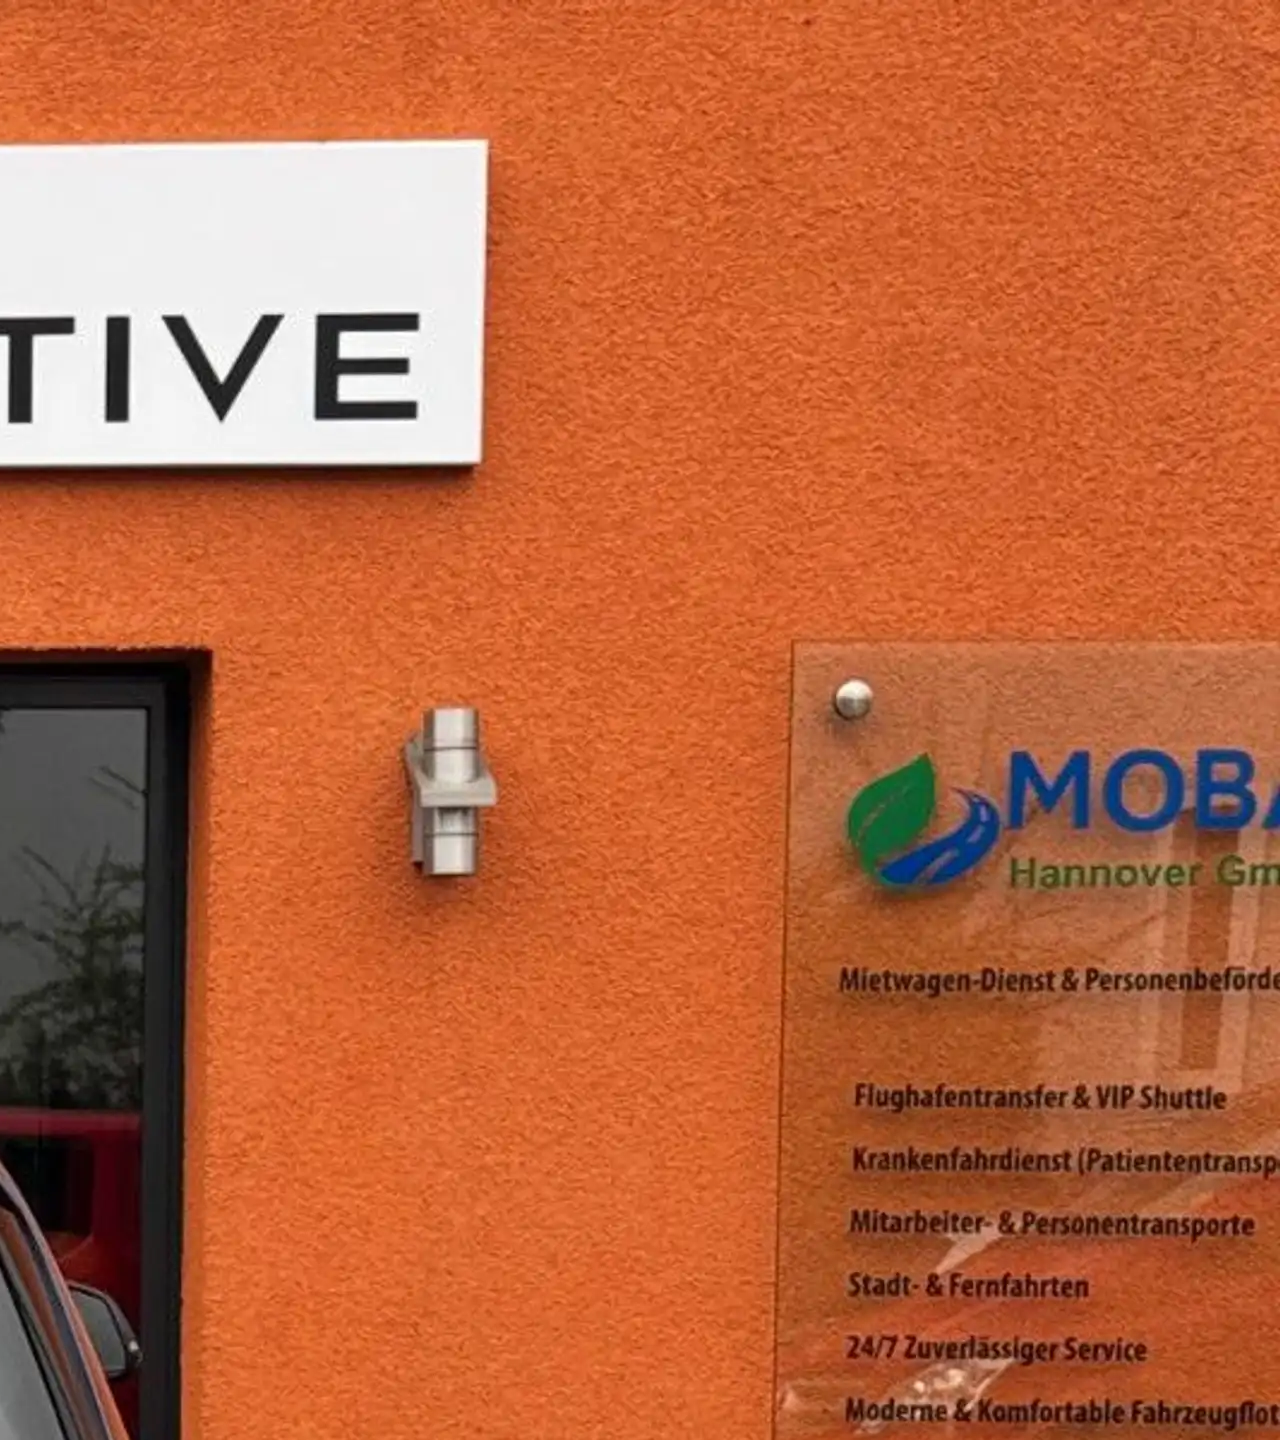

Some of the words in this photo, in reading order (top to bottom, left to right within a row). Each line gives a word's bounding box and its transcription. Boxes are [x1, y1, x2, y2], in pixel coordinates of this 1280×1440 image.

[1010, 857, 1201, 889] Hannover
[840, 967, 1055, 999] Mietwagen-Dienst
[1062, 968, 1079, 993] &
[854, 1083, 1068, 1113] Flughafentransfer
[1074, 1086, 1091, 1110] &
[1095, 1085, 1134, 1110] VIP
[1139, 1085, 1227, 1110] Shuttle
[853, 1147, 1071, 1173] Krankenfahrdienst
[849, 1210, 991, 1235] Mitarbeiter-
[998, 1211, 1016, 1236] &
[1021, 1211, 1255, 1244] Personentransporte
[848, 1272, 919, 1297] Stadt-
[926, 1273, 944, 1297] &
[949, 1273, 1089, 1298] Fernfahrten
[846, 1335, 898, 1360] 24/7
[904, 1335, 1058, 1366] Zuverlässiger
[1063, 1336, 1147, 1362] Service
[845, 1397, 948, 1422] Moderne
[953, 1399, 972, 1423] &
[978, 1399, 1125, 1424] Komfortable
